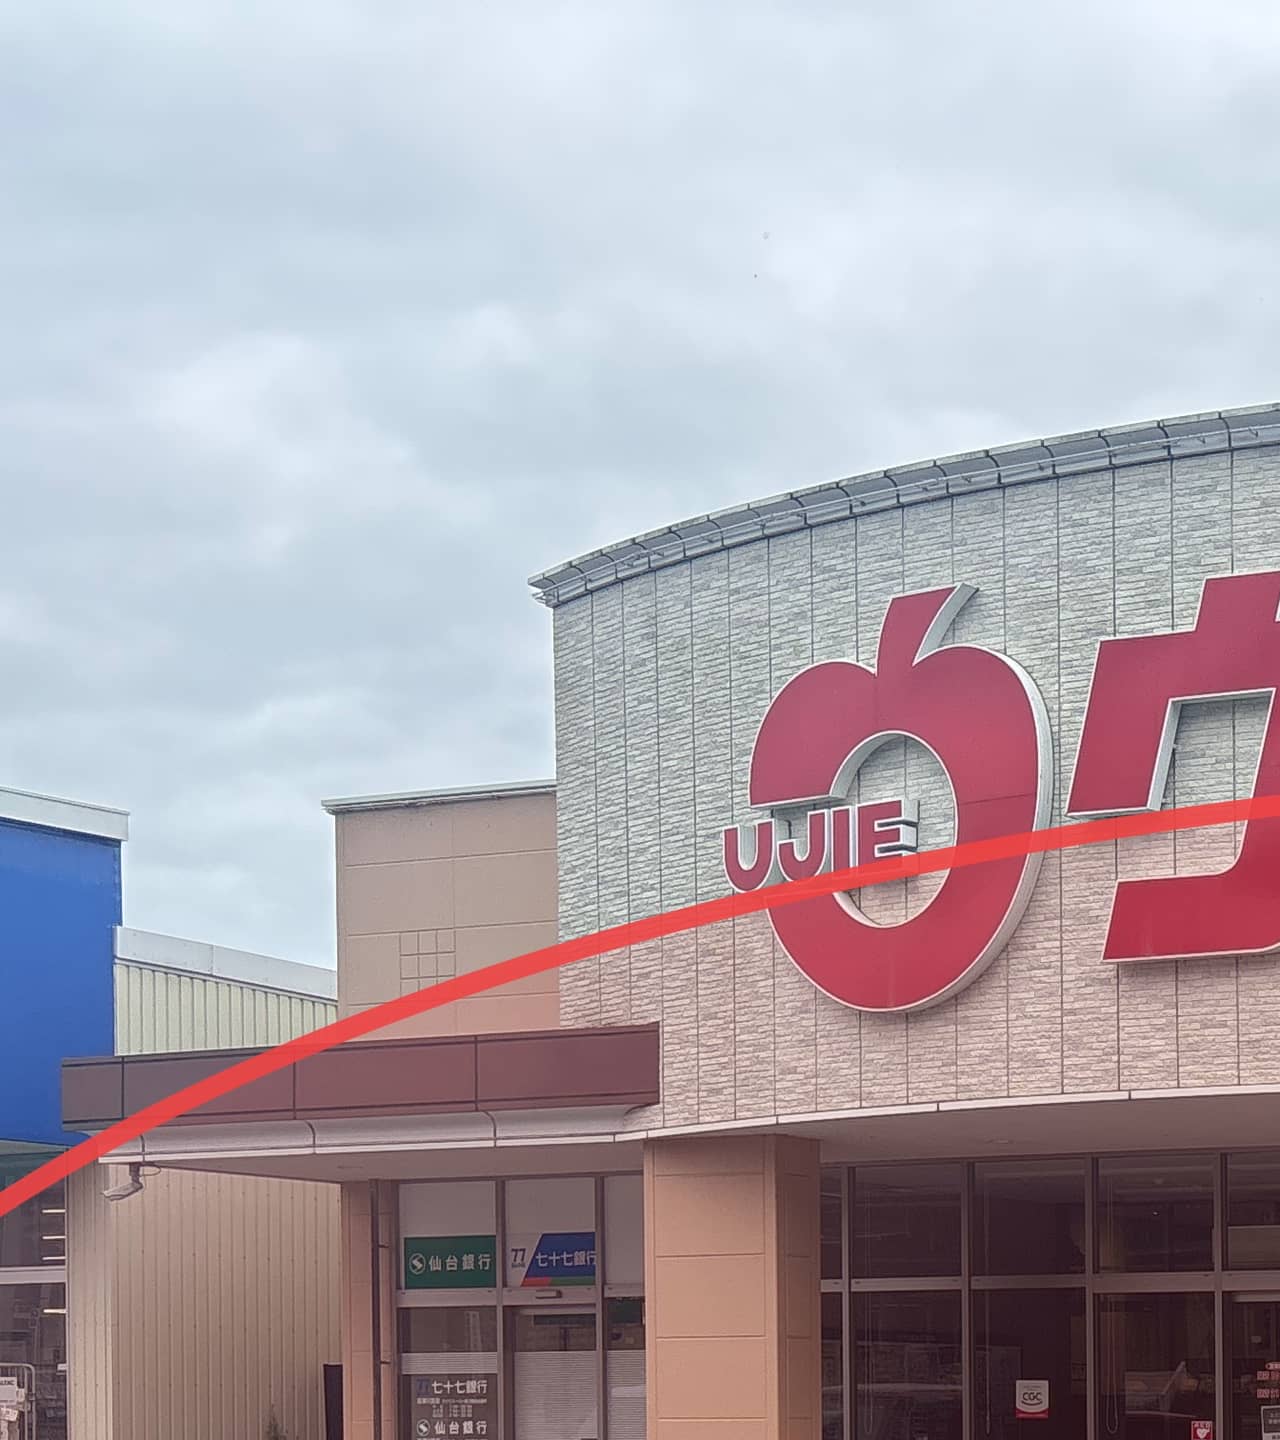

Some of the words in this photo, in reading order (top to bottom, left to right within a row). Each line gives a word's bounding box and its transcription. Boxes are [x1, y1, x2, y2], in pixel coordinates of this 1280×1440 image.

[723, 799, 908, 893] UJIE
[428, 1254, 492, 1272] 仙台銀行
[431, 1380, 488, 1395] 七十七銀行
[434, 1421, 488, 1435] 仙台銀行
